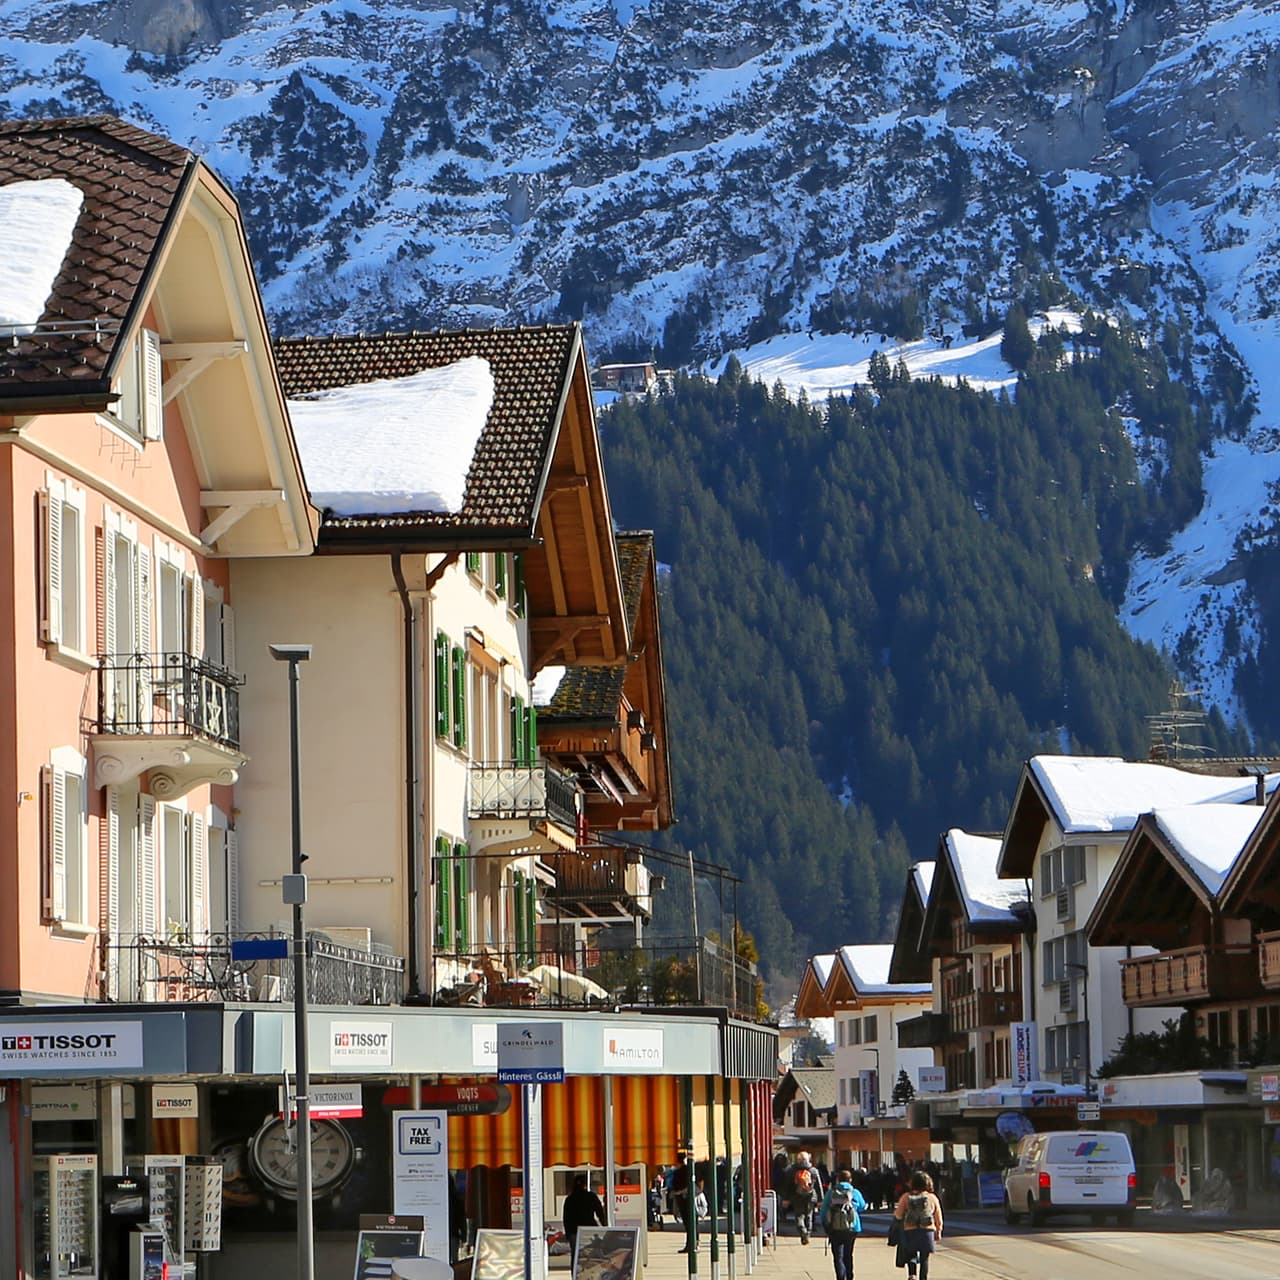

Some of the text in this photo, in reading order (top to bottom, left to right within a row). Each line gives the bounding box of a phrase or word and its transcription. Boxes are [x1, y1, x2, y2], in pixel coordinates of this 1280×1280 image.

[33, 1034, 116, 1049] TISSOT
[350, 1033, 388, 1047] TISSOT
[483, 1041, 498, 1054] SW
[1016, 1026, 1025, 1074] INTERSPORT
[2, 1052, 28, 1060] SWISS
[31, 1051, 69, 1059] WATCHES
[72, 1050, 96, 1058] SINCE
[613, 1048, 660, 1059] HAMILTON
[499, 1070, 562, 1082] Hinteres Gässli
[314, 1092, 353, 1102] VICTORINOX
[1046, 1096, 1084, 1105] INTER
[166, 1098, 193, 1108] TISSOT
[457, 1103, 479, 1113] CORNER
[411, 1128, 429, 1136] TAX
[409, 1136, 431, 1145] FREE
